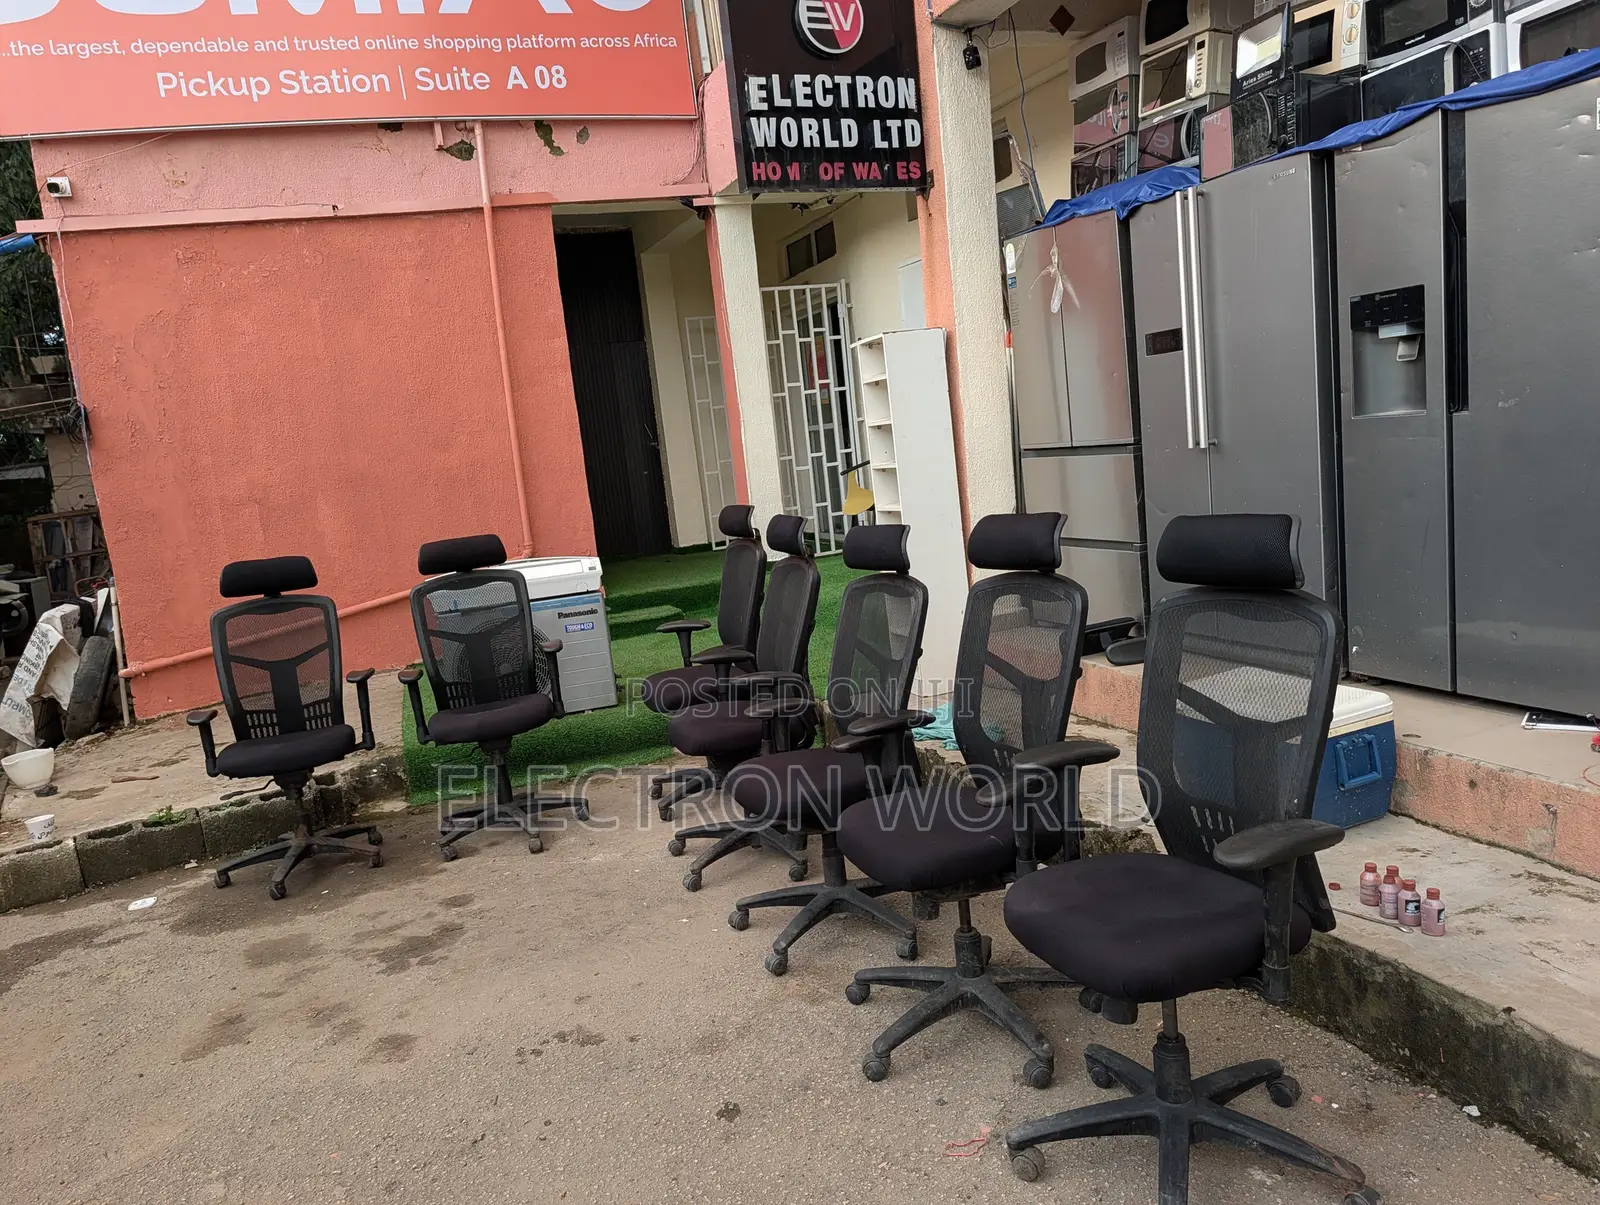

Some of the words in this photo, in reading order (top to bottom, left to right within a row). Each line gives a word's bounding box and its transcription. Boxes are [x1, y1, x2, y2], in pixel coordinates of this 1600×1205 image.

[49, 39, 126, 59] largest,
[131, 37, 249, 57] dependable
[254, 36, 289, 53] and
[293, 35, 360, 52] trusted
[364, 34, 419, 51] online
[423, 34, 502, 52] shopping
[506, 33, 576, 52] platform
[580, 36, 631, 49] across
[633, 33, 678, 49] Africa
[156, 70, 270, 102] Pickup
[278, 67, 391, 95] Station
[415, 65, 490, 93] Suite
[506, 66, 528, 90] A
[534, 65, 567, 89] 08
[746, 74, 918, 112] ELECTRON
[749, 117, 859, 148] WORLD
[872, 119, 922, 149] LTD
[752, 162, 811, 181] HOM
[819, 162, 845, 181] OF
[852, 161, 922, 181] WAES
[557, 607, 599, 619] Panasonic
